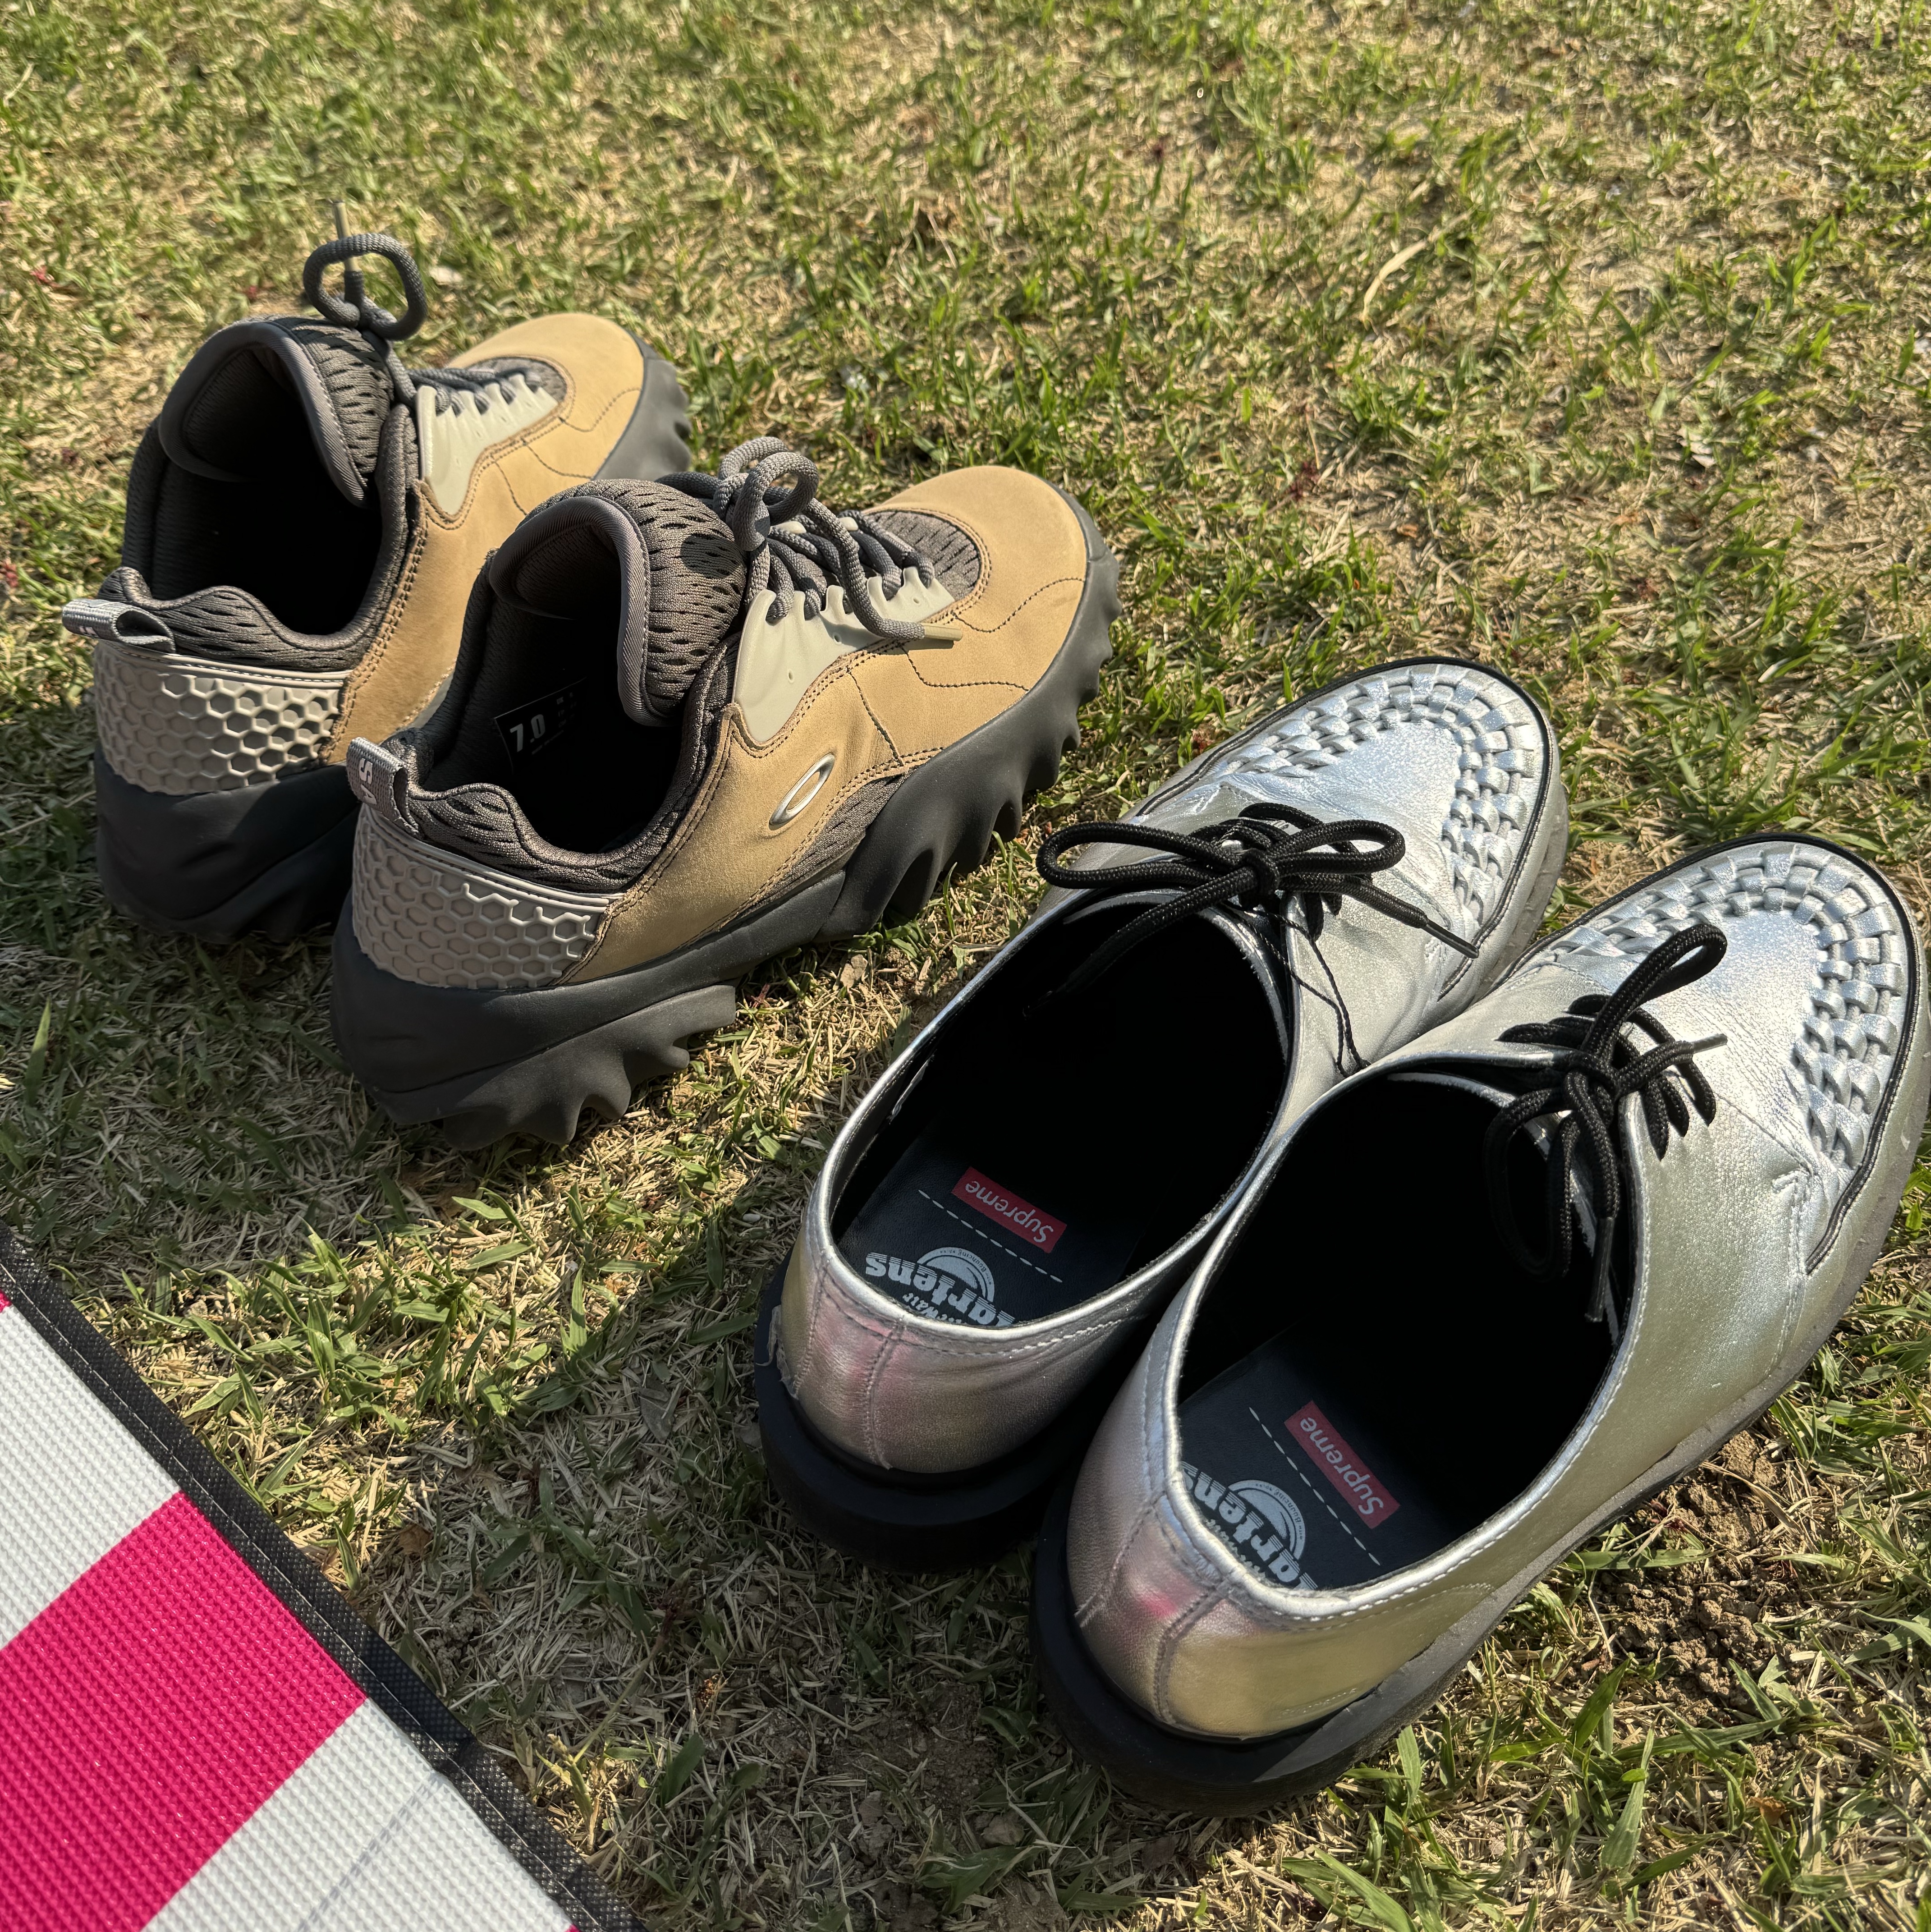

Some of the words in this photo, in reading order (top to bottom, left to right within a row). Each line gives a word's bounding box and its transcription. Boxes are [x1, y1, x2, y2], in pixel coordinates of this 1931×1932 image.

[509, 714, 546, 753] 7.0
[965, 1180, 1054, 1244] Supreme
[1300, 1417, 1384, 1515] Supreme
[1181, 1460, 1318, 1590] arten
